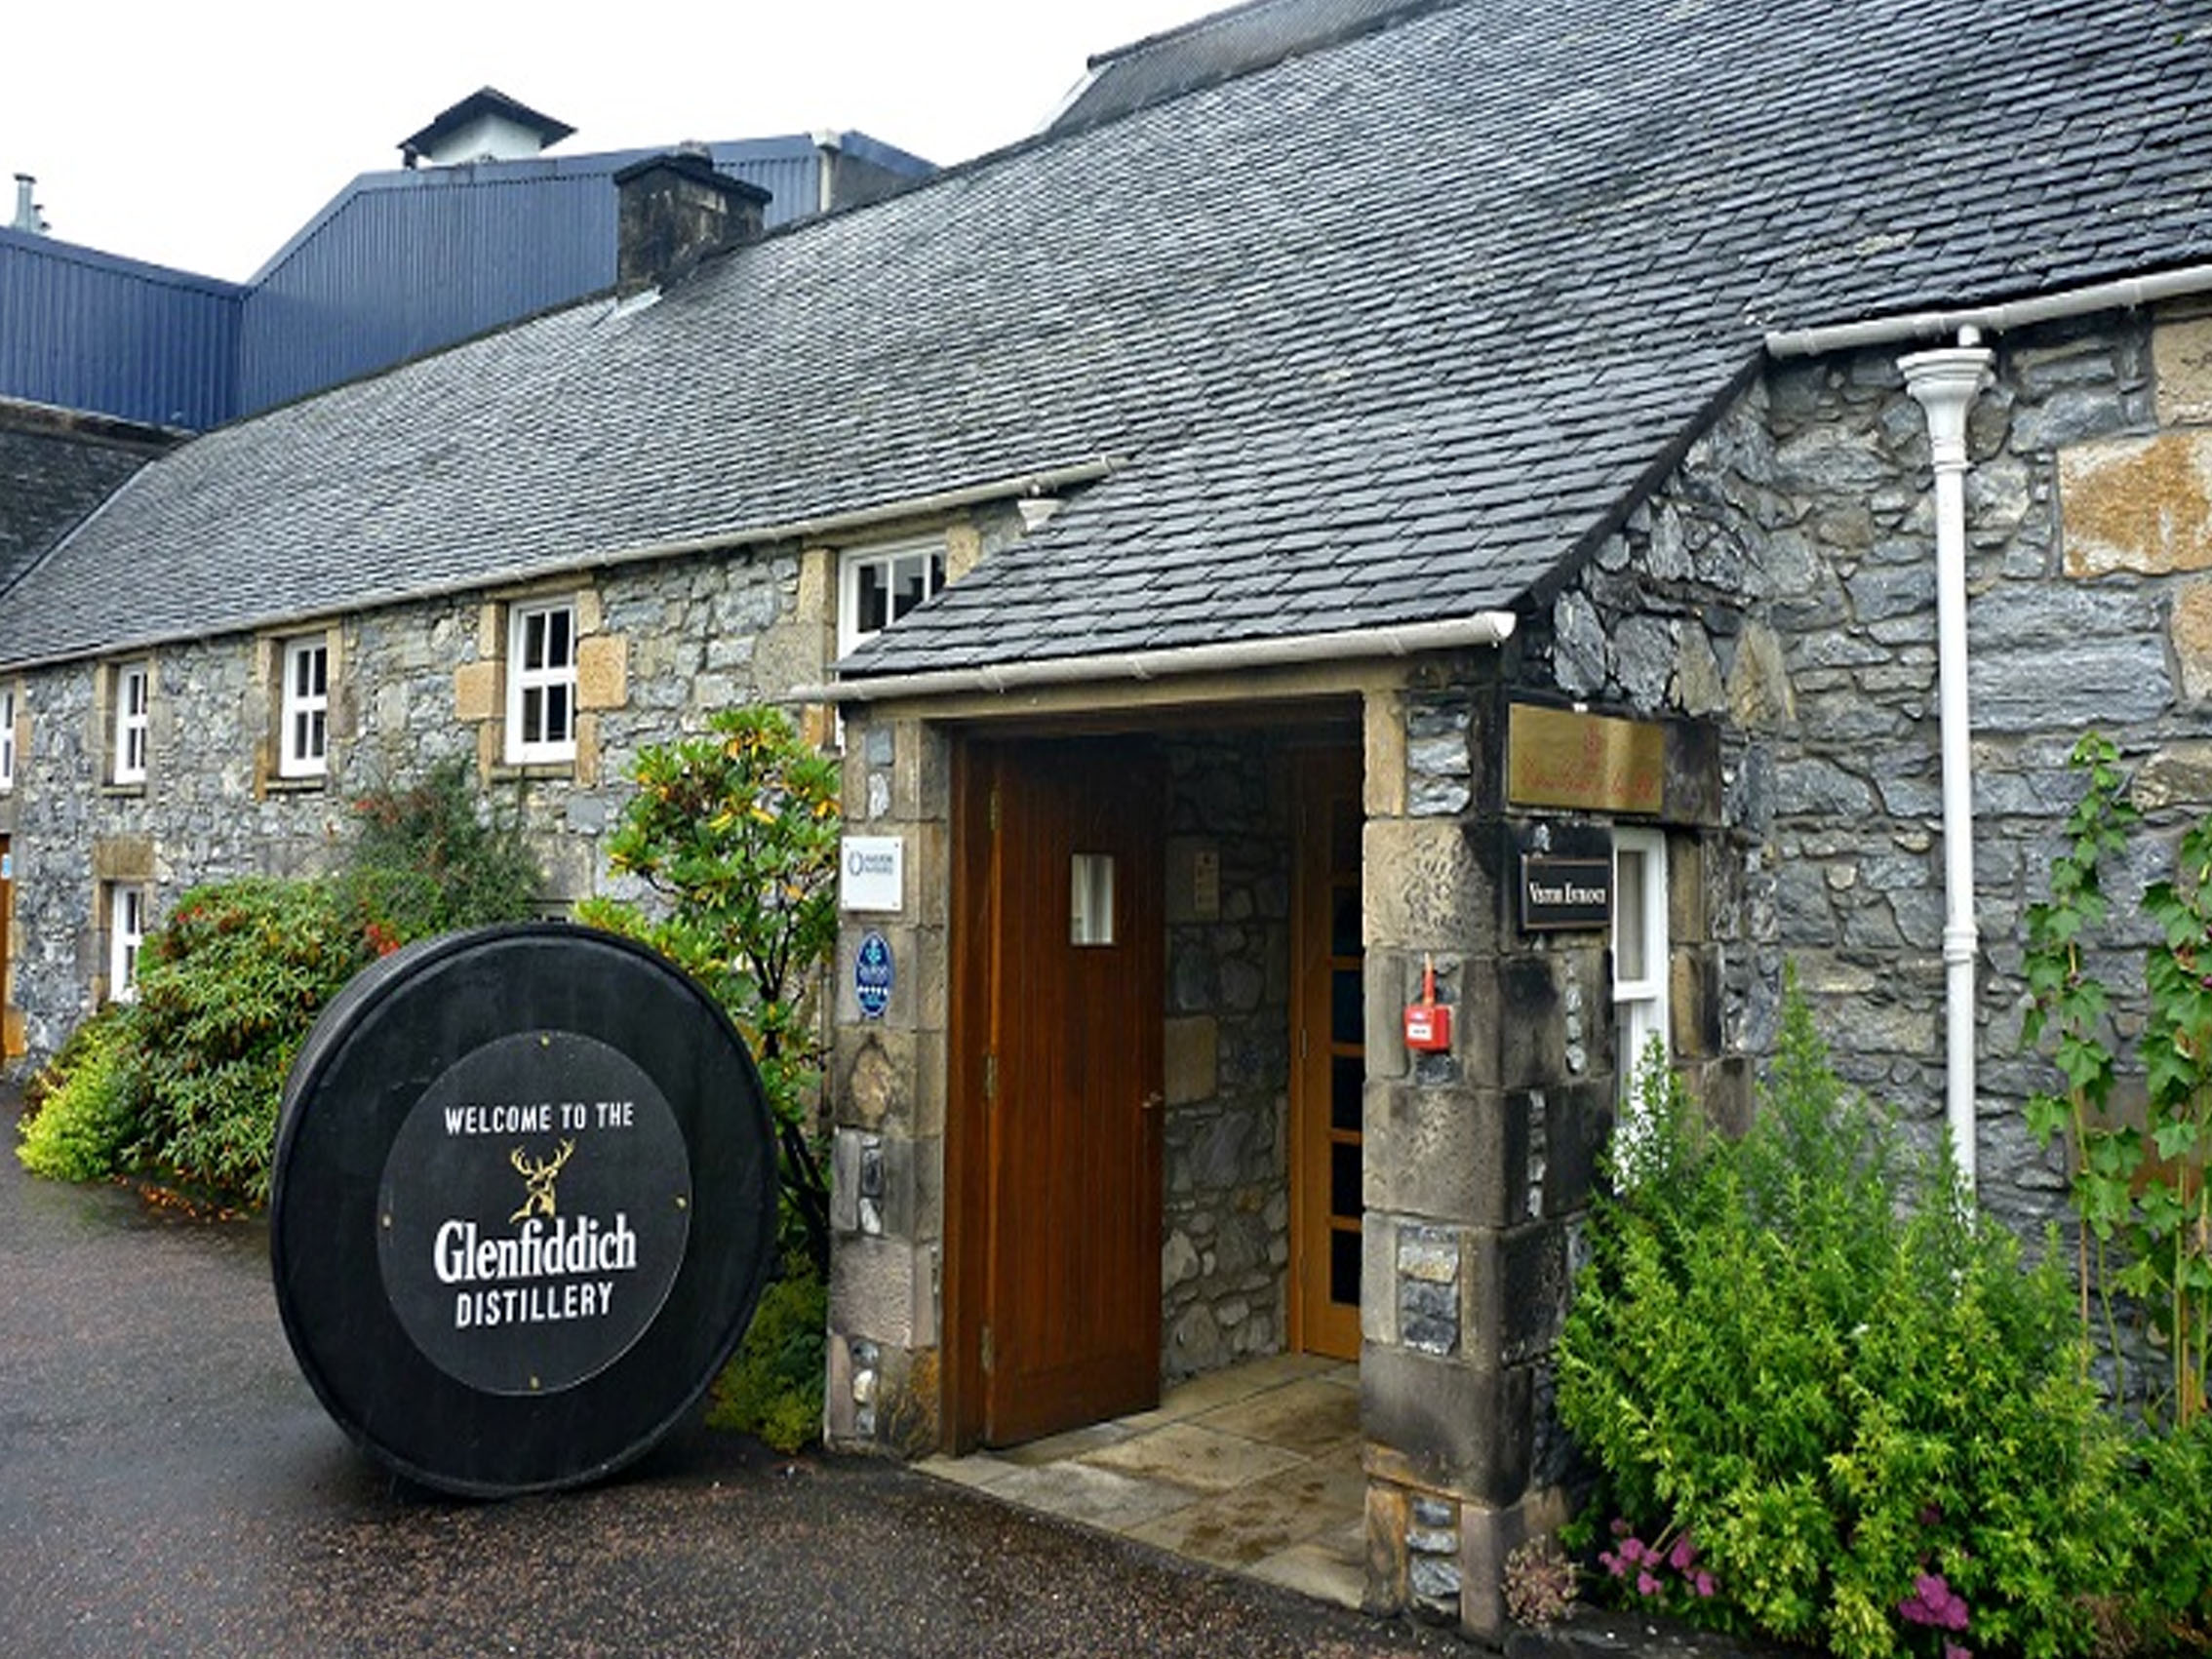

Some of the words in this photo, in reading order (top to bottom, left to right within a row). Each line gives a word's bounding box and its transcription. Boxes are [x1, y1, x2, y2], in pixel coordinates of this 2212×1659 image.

[444, 1103, 552, 1136] WELCOME
[560, 1102, 587, 1130] TO
[595, 1100, 635, 1128] THE
[432, 1210, 638, 1285] Glenfiddich
[454, 1281, 614, 1329] DISTILLERY
